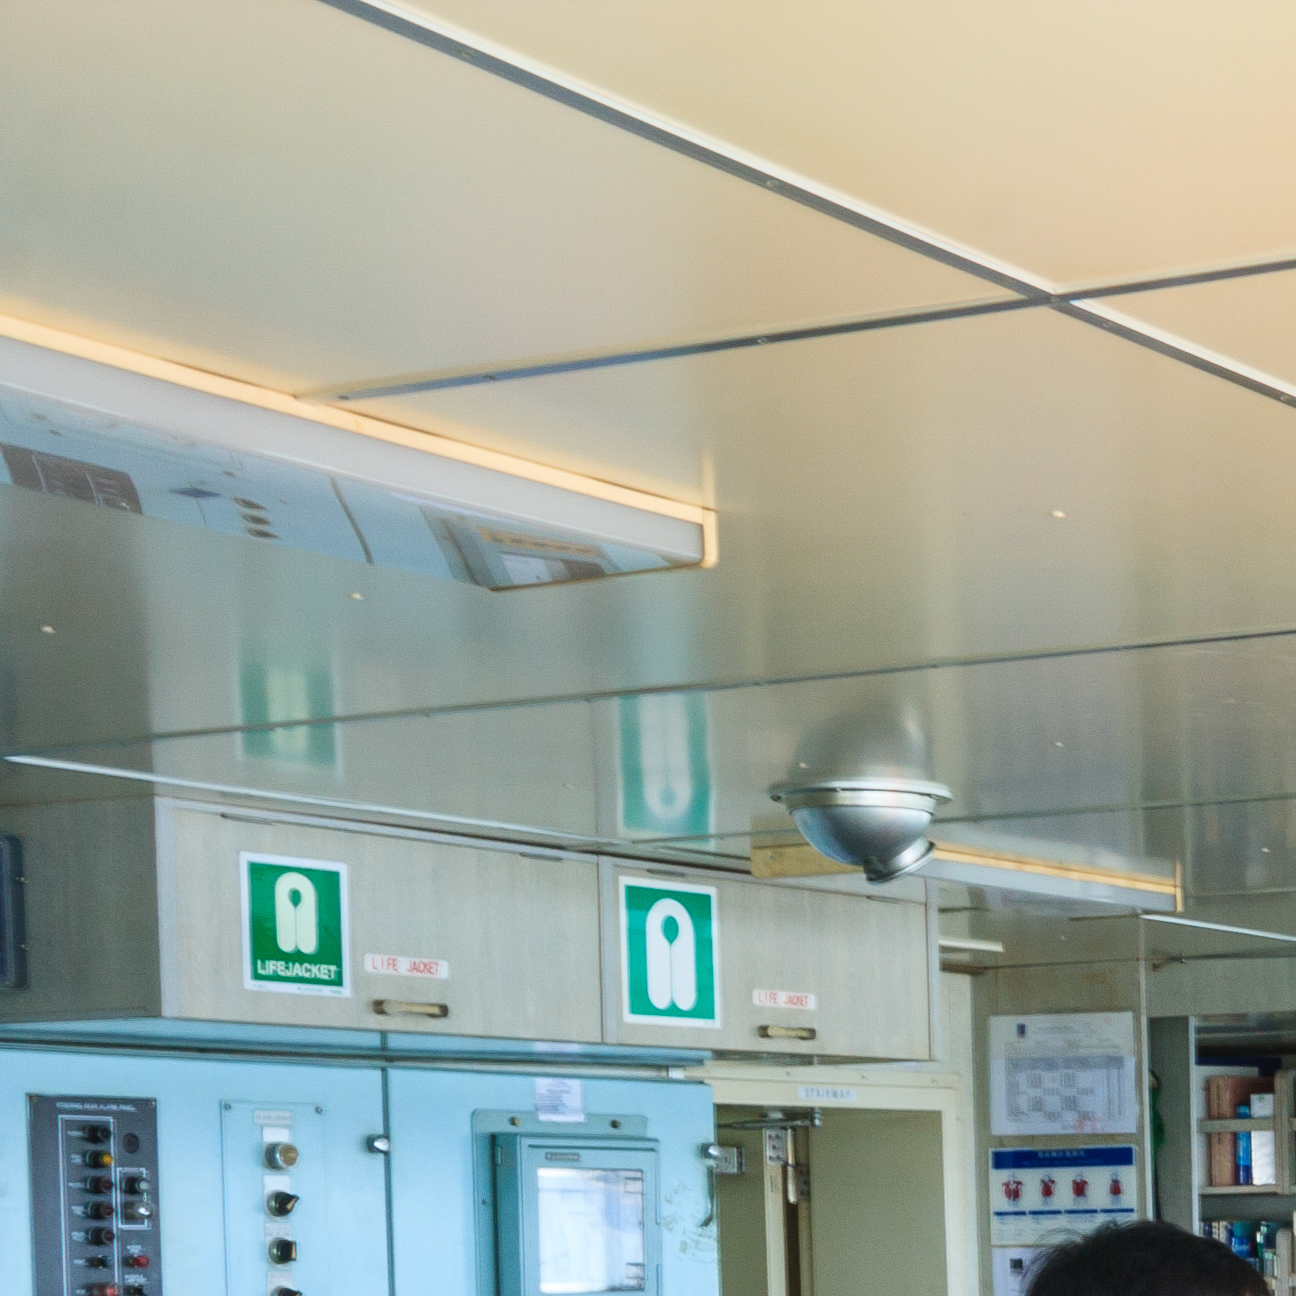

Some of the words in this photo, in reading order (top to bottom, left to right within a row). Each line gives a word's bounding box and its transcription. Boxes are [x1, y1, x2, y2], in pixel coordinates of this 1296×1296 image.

[255, 959, 339, 981] LIFEJACKET
[370, 956, 399, 973] LIFE
[405, 960, 440, 976] JACKET
[757, 991, 778, 1005] LIFE
[803, 1087, 851, 1100] STAIRWAY
